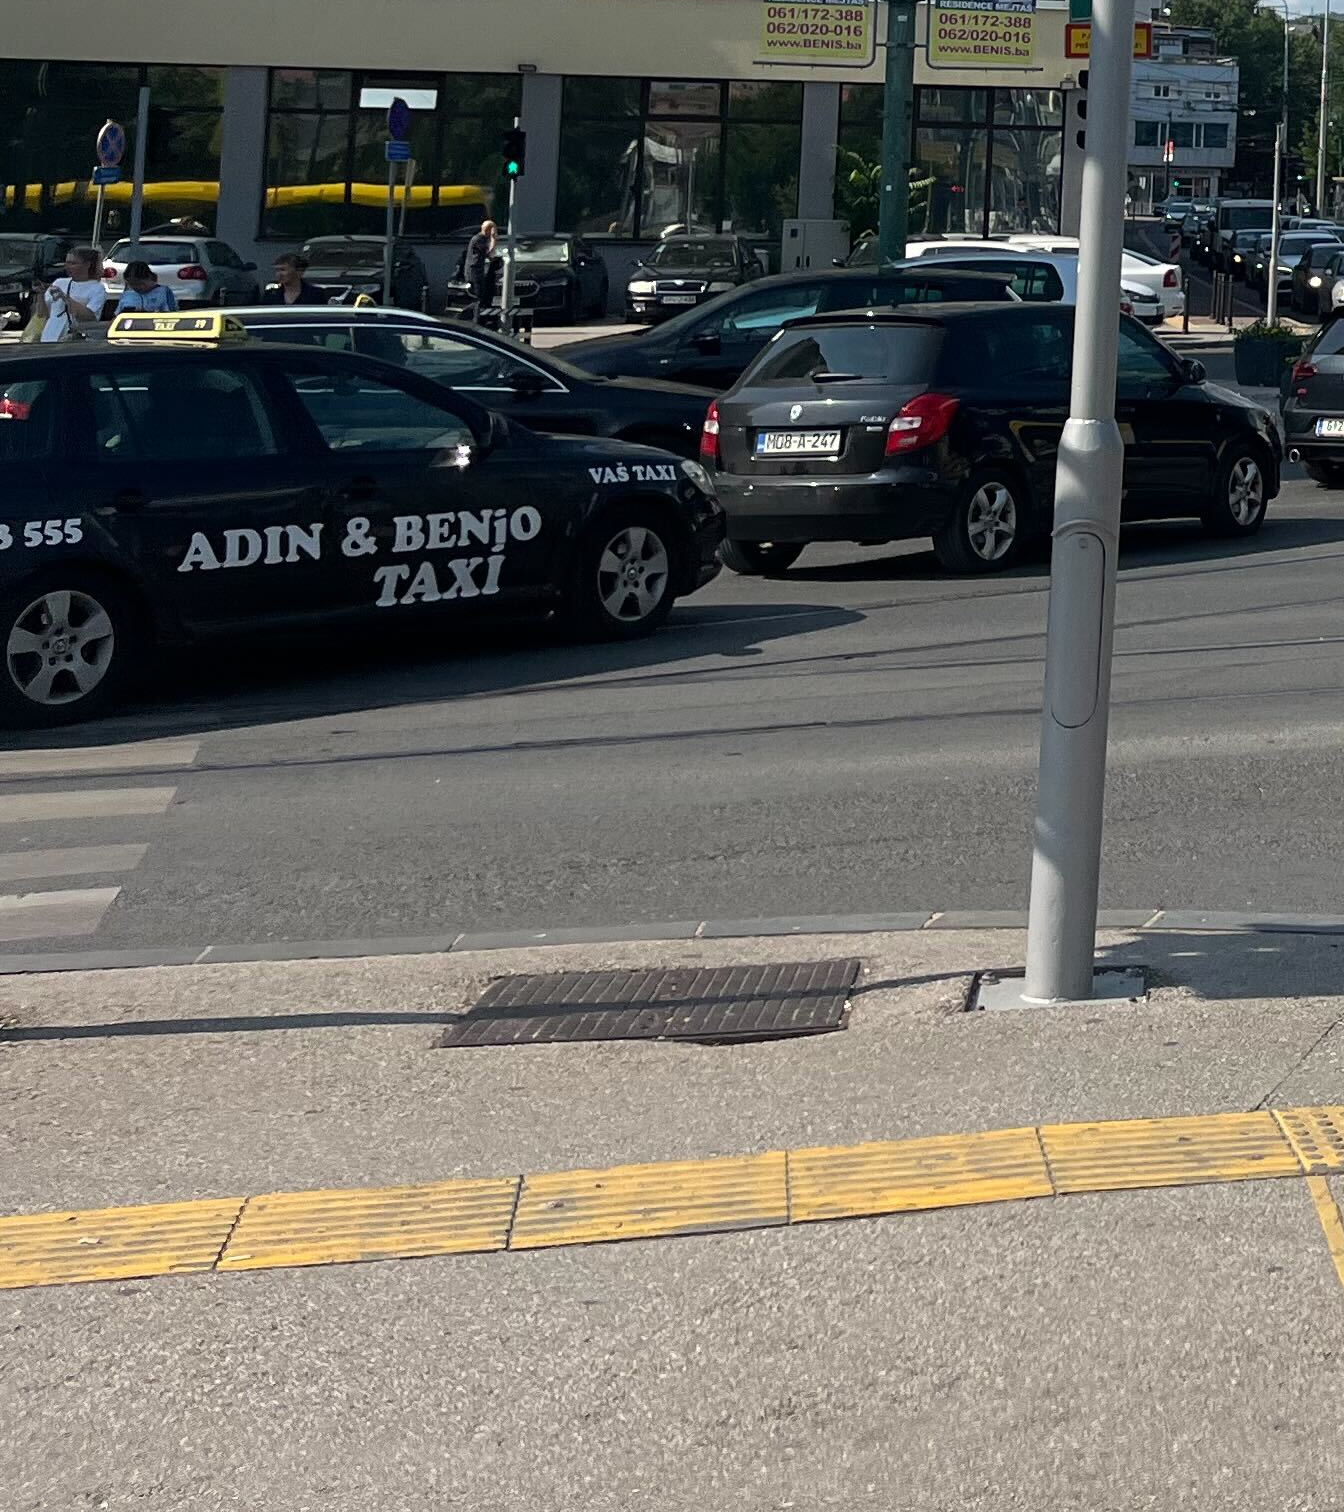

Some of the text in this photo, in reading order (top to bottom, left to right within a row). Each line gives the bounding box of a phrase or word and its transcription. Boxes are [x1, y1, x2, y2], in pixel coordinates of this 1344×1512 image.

[940, 0, 994, 11] RESIDENCE
[767, 6, 864, 22] 061/172-388
[940, 13, 1032, 29] 061/172-388
[766, 22, 863, 38] 062/020-016
[938, 28, 1032, 44] 062/020-016
[767, 38, 862, 50] www.BENIS.ba
[939, 45, 1030, 57] www.BENIS.ba
[588, 462, 677, 485] VAŠ TAXI
[23, 518, 83, 547] 555
[177, 521, 324, 572] ADIN
[341, 517, 378, 557] &
[373, 554, 506, 607] TAXI
